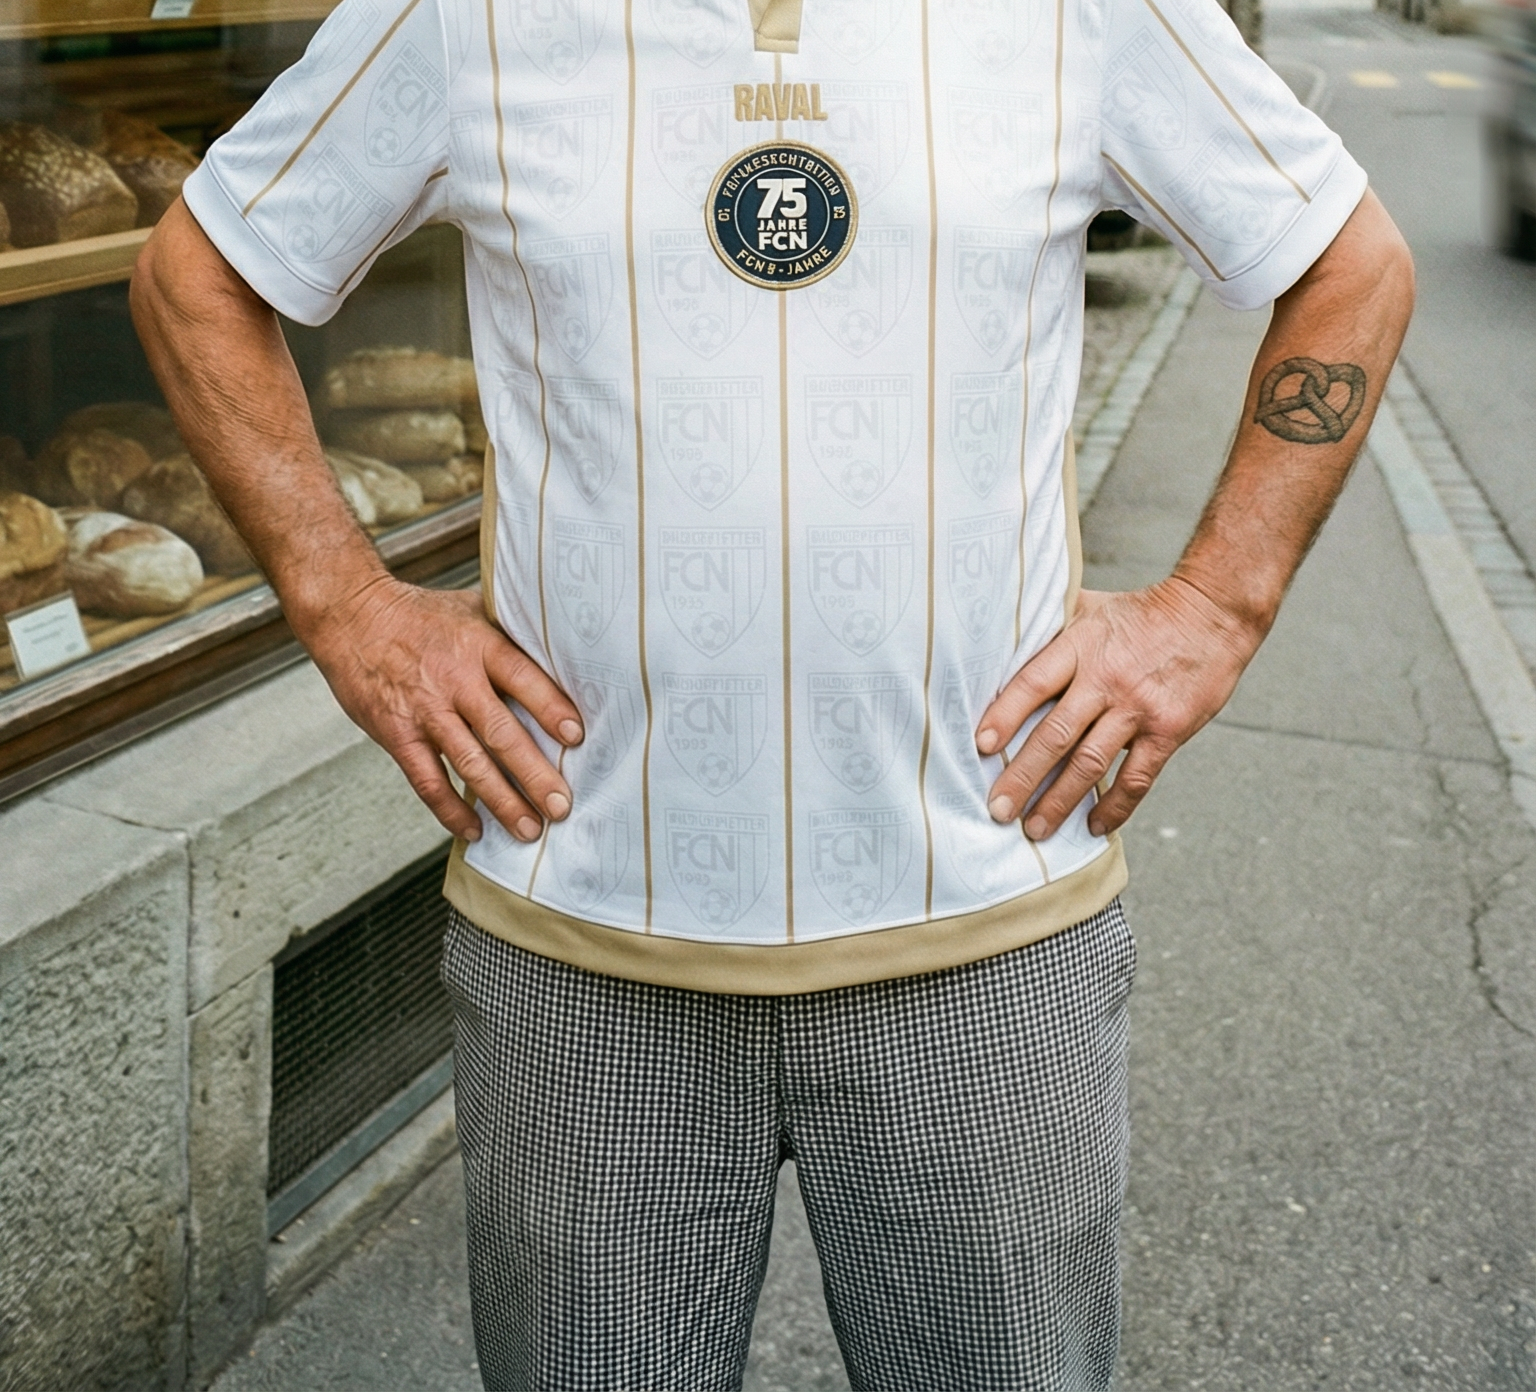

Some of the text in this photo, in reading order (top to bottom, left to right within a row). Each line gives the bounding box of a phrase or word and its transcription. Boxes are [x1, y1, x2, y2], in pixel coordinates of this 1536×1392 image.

[734, 83, 828, 122] RAVAL
[657, 104, 724, 150] FCN
[756, 178, 808, 219] 75
[757, 218, 808, 231] JAHRE
[758, 231, 808, 251] FCN
[658, 254, 727, 296] FCN
[958, 250, 1009, 291] FCN
[662, 401, 729, 444] FCN
[810, 400, 879, 441] FCN
[954, 396, 999, 437] FCN
[663, 551, 729, 593] FCN
[812, 549, 880, 592] FCN
[667, 696, 733, 736] FCN
[813, 694, 879, 735] FCN
[671, 831, 735, 872] FCN
[814, 828, 879, 871] FCN
